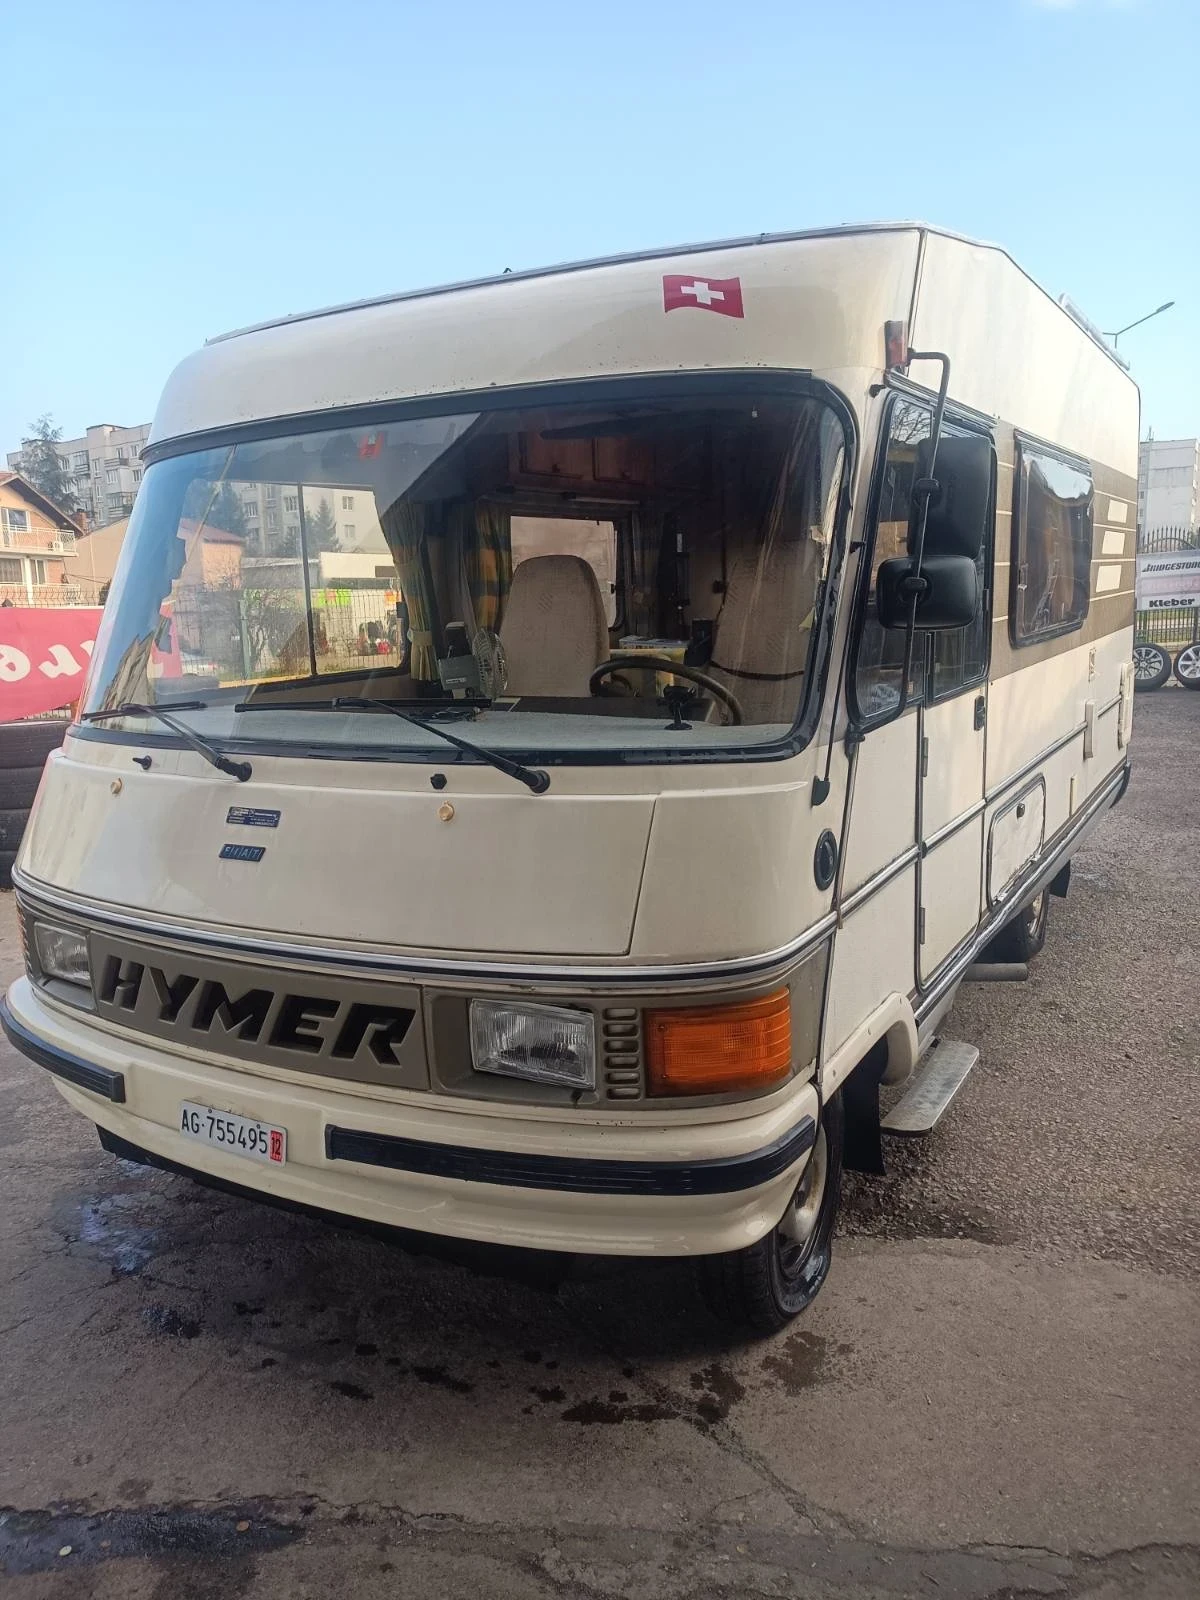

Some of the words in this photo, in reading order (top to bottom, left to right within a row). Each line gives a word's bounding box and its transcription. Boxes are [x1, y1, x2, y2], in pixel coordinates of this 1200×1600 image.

[1149, 598, 1196, 608] Kleber
[223, 846, 261, 859] FIAT
[100, 954, 416, 1067] HYMER
[272, 1137, 282, 1156] 12
